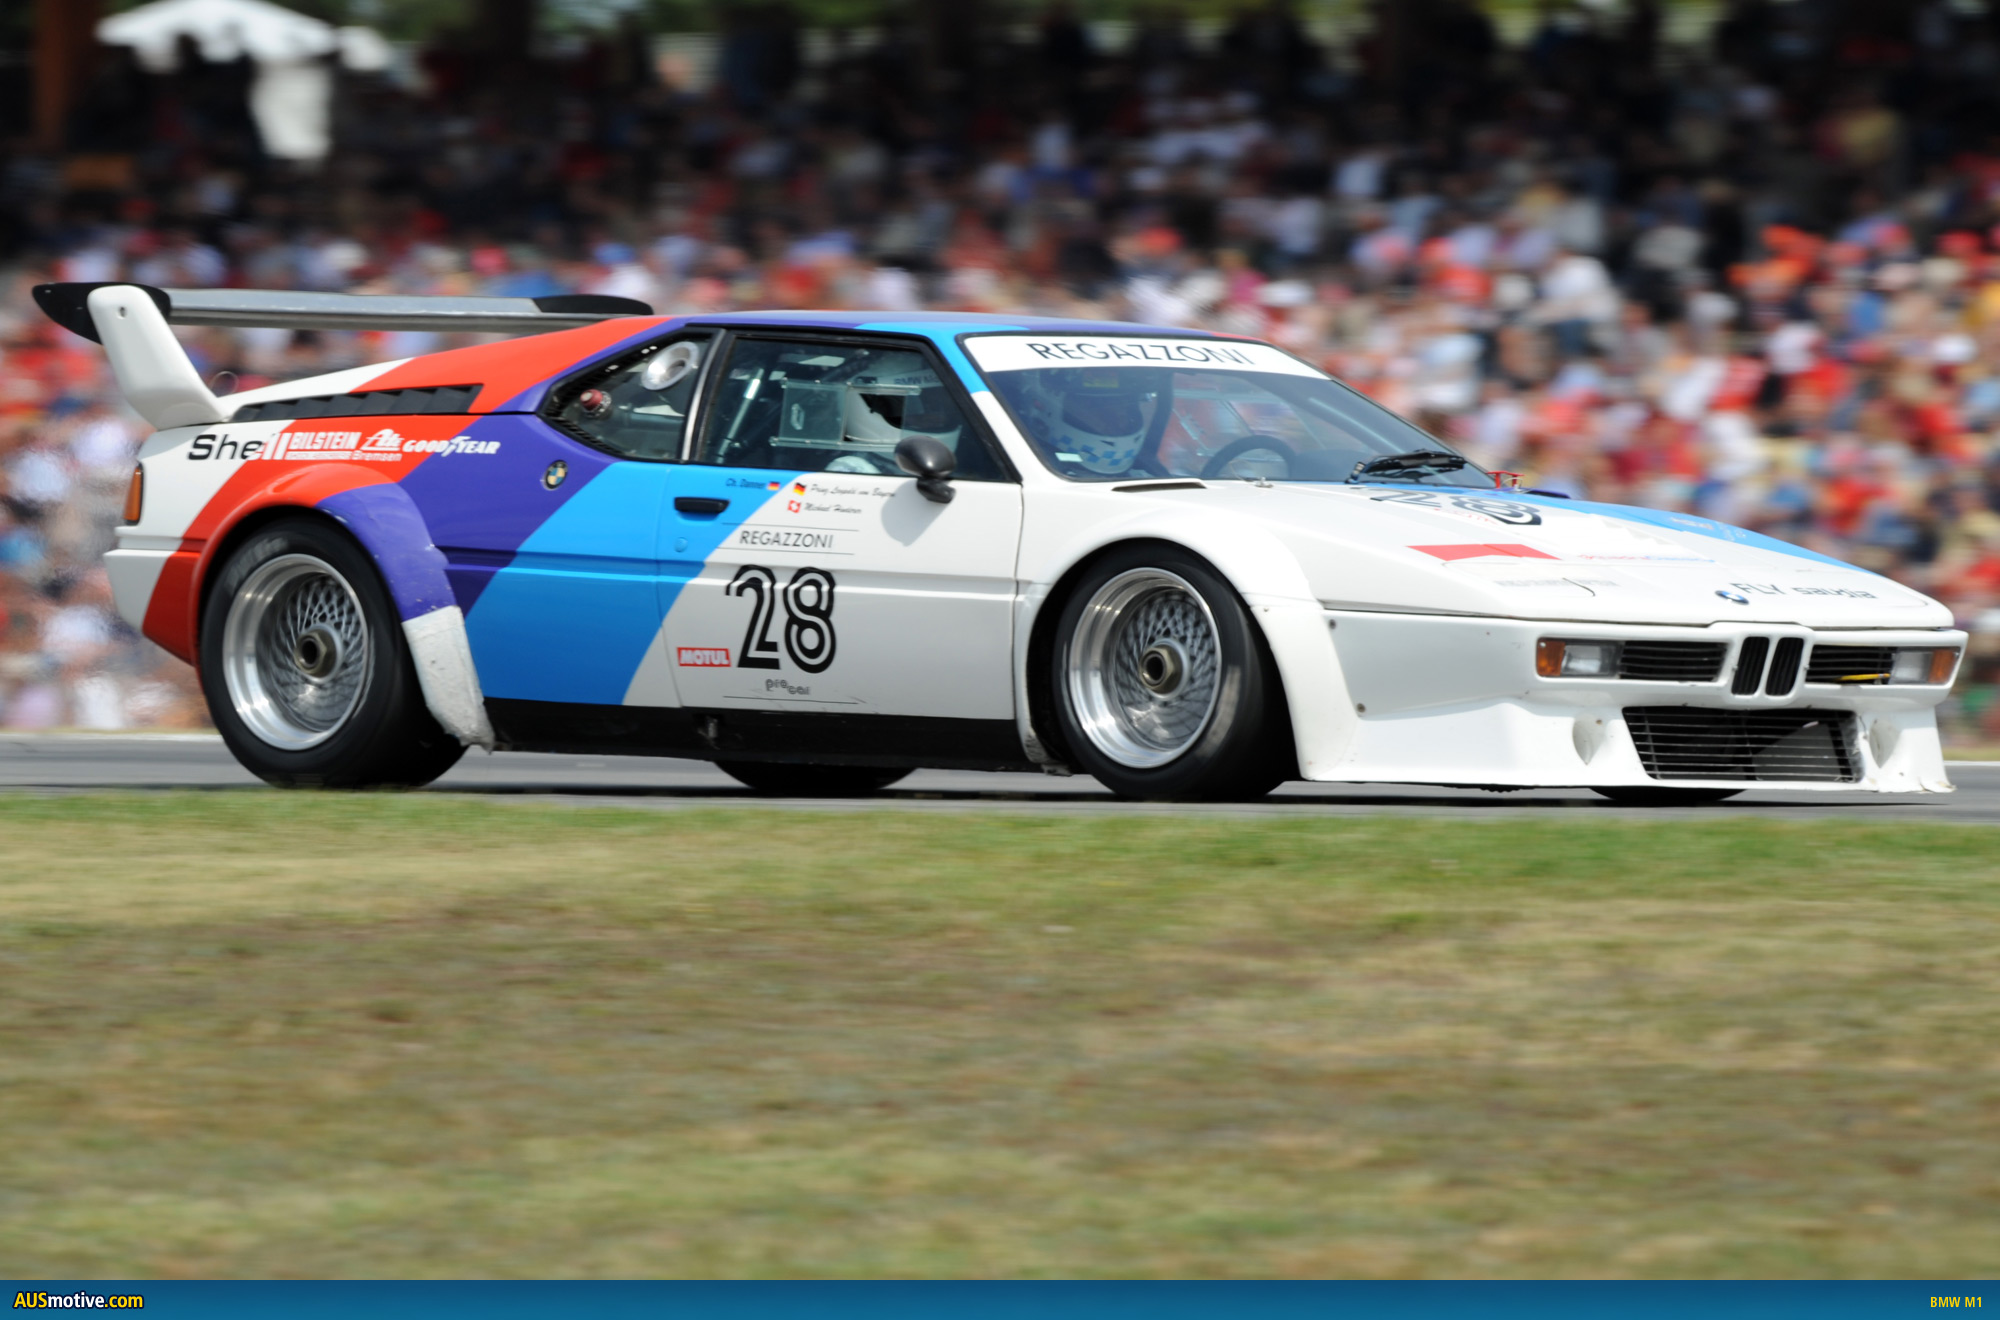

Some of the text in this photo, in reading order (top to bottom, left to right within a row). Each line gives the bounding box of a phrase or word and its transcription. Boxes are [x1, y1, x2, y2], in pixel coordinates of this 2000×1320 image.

[1027, 342, 1256, 365] REGAZZONI
[187, 432, 292, 461] Shell
[289, 431, 362, 450] BILSTEIN
[739, 530, 834, 549] REGAZZONI
[1730, 582, 1788, 595] FLY
[725, 564, 837, 674] 28
[679, 649, 730, 665] MOTUL
